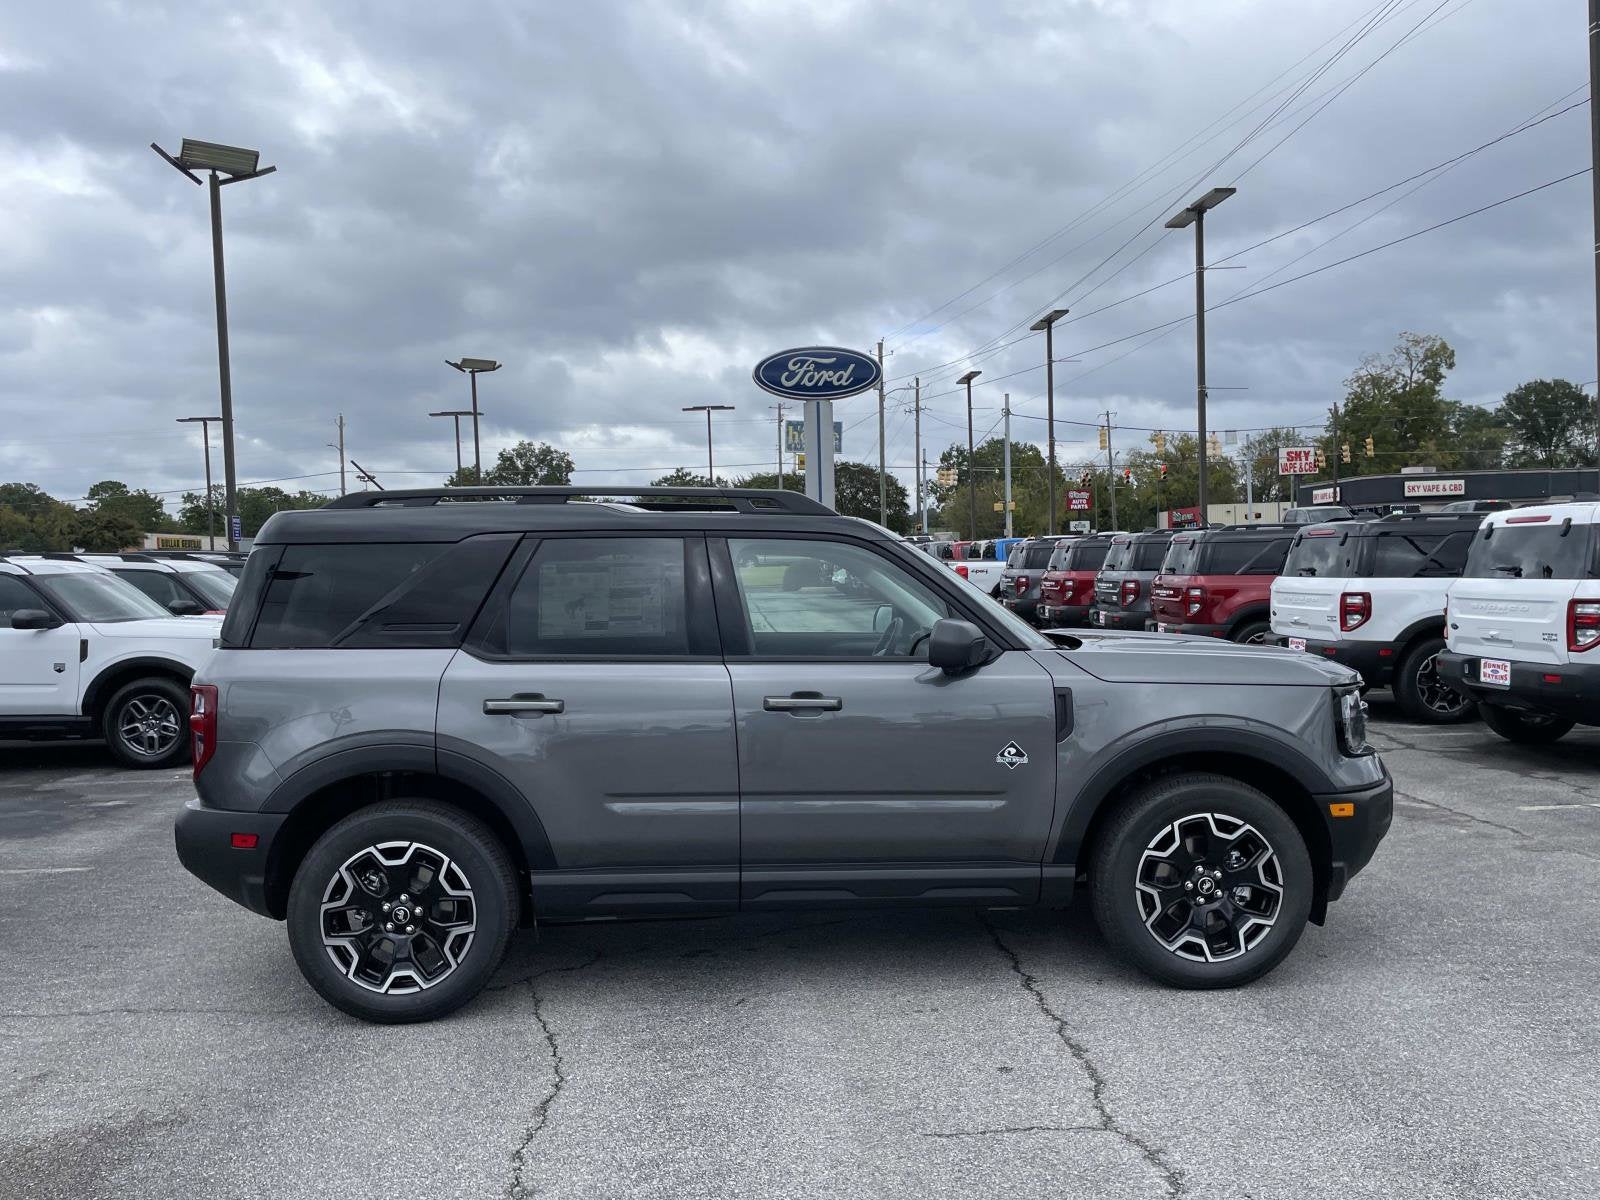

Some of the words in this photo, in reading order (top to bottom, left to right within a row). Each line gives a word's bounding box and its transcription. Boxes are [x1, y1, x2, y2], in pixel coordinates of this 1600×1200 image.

[781, 357, 855, 387] Ford
[1286, 450, 1311, 462] SKY
[1280, 462, 1297, 473] VAPE
[1406, 485, 1421, 493] SKY
[1422, 484, 1440, 493] VAPE
[1449, 483, 1463, 492] CBD
[161, 537, 180, 548] DOLLAR
[1482, 661, 1508, 672] RONNIE
[1482, 671, 1508, 682] WATKINS
